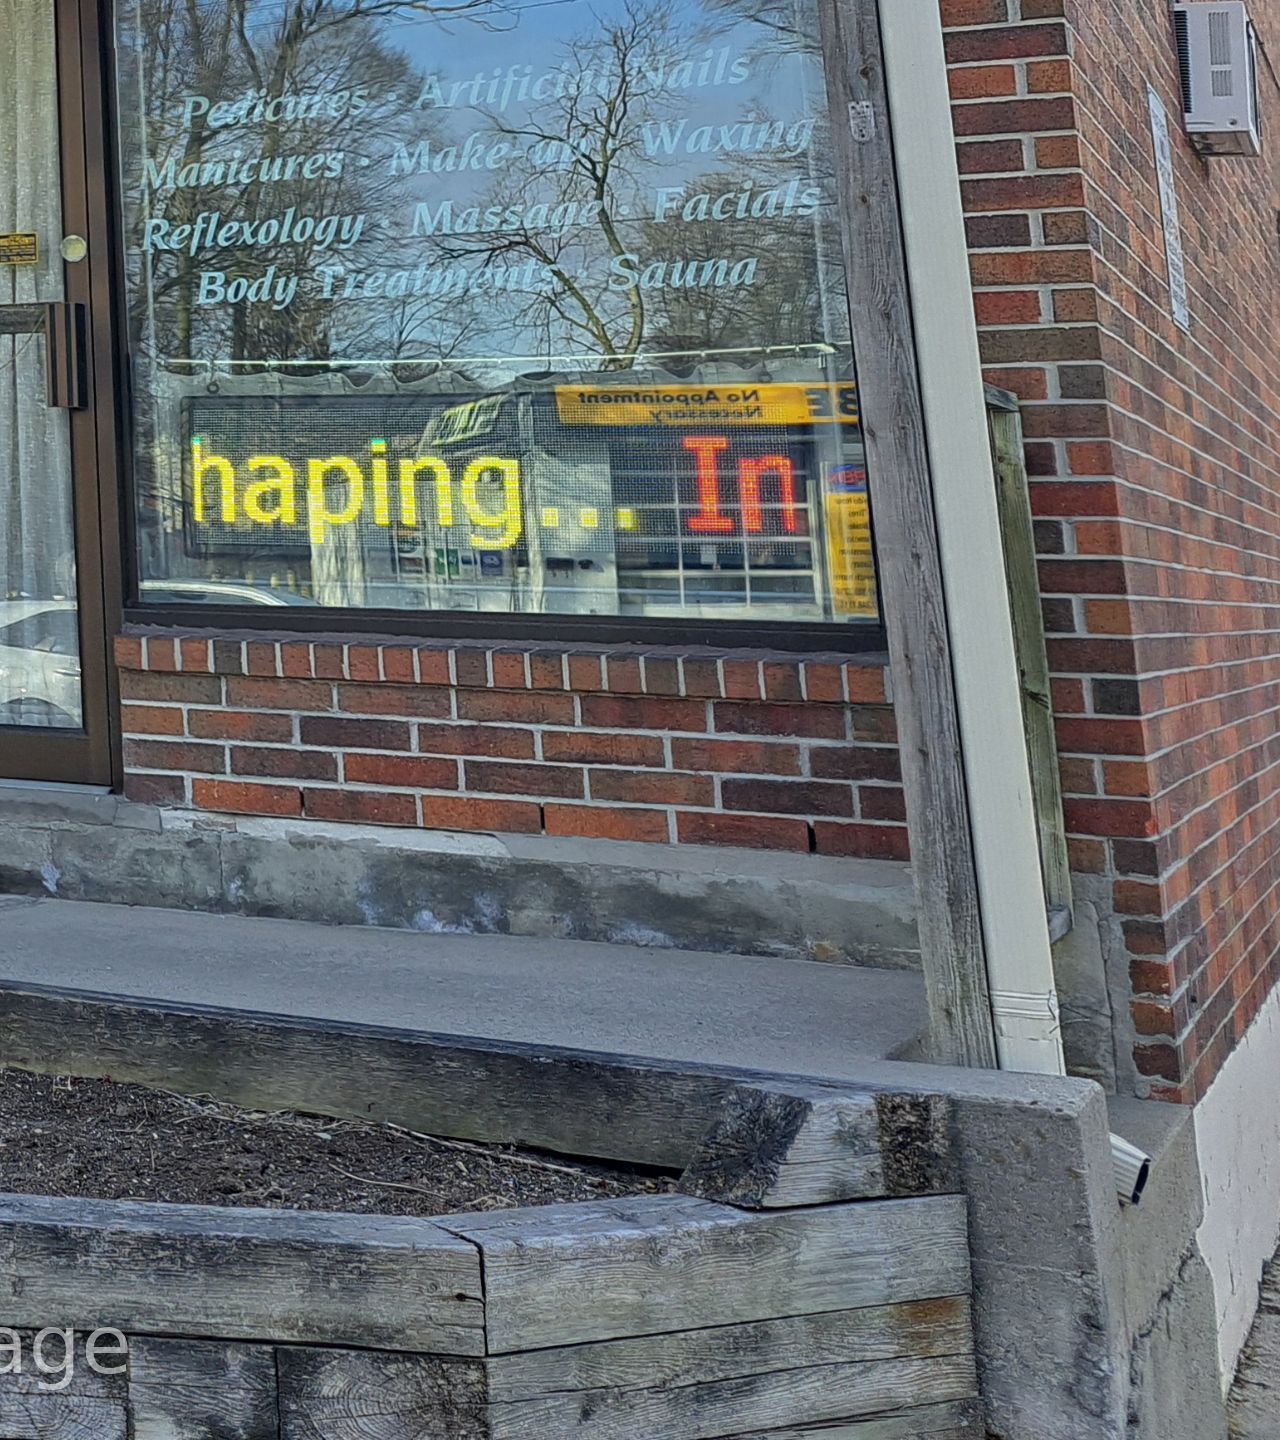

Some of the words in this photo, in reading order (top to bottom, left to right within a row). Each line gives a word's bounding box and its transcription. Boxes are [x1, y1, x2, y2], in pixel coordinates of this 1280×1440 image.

[182, 88, 370, 128] Pedicures
[414, 58, 618, 112] Artificial
[642, 46, 751, 90] Nails
[142, 150, 344, 190] Manicures
[389, 131, 588, 177] Make-up
[644, 112, 816, 159] Waxing
[142, 206, 366, 257] Reflexology
[410, 198, 604, 239] Massage
[651, 175, 823, 224] Facials
[196, 264, 299, 310] Body
[314, 258, 558, 300] Treatments
[607, 253, 759, 292] Sauna
[681, 436, 796, 533] In
